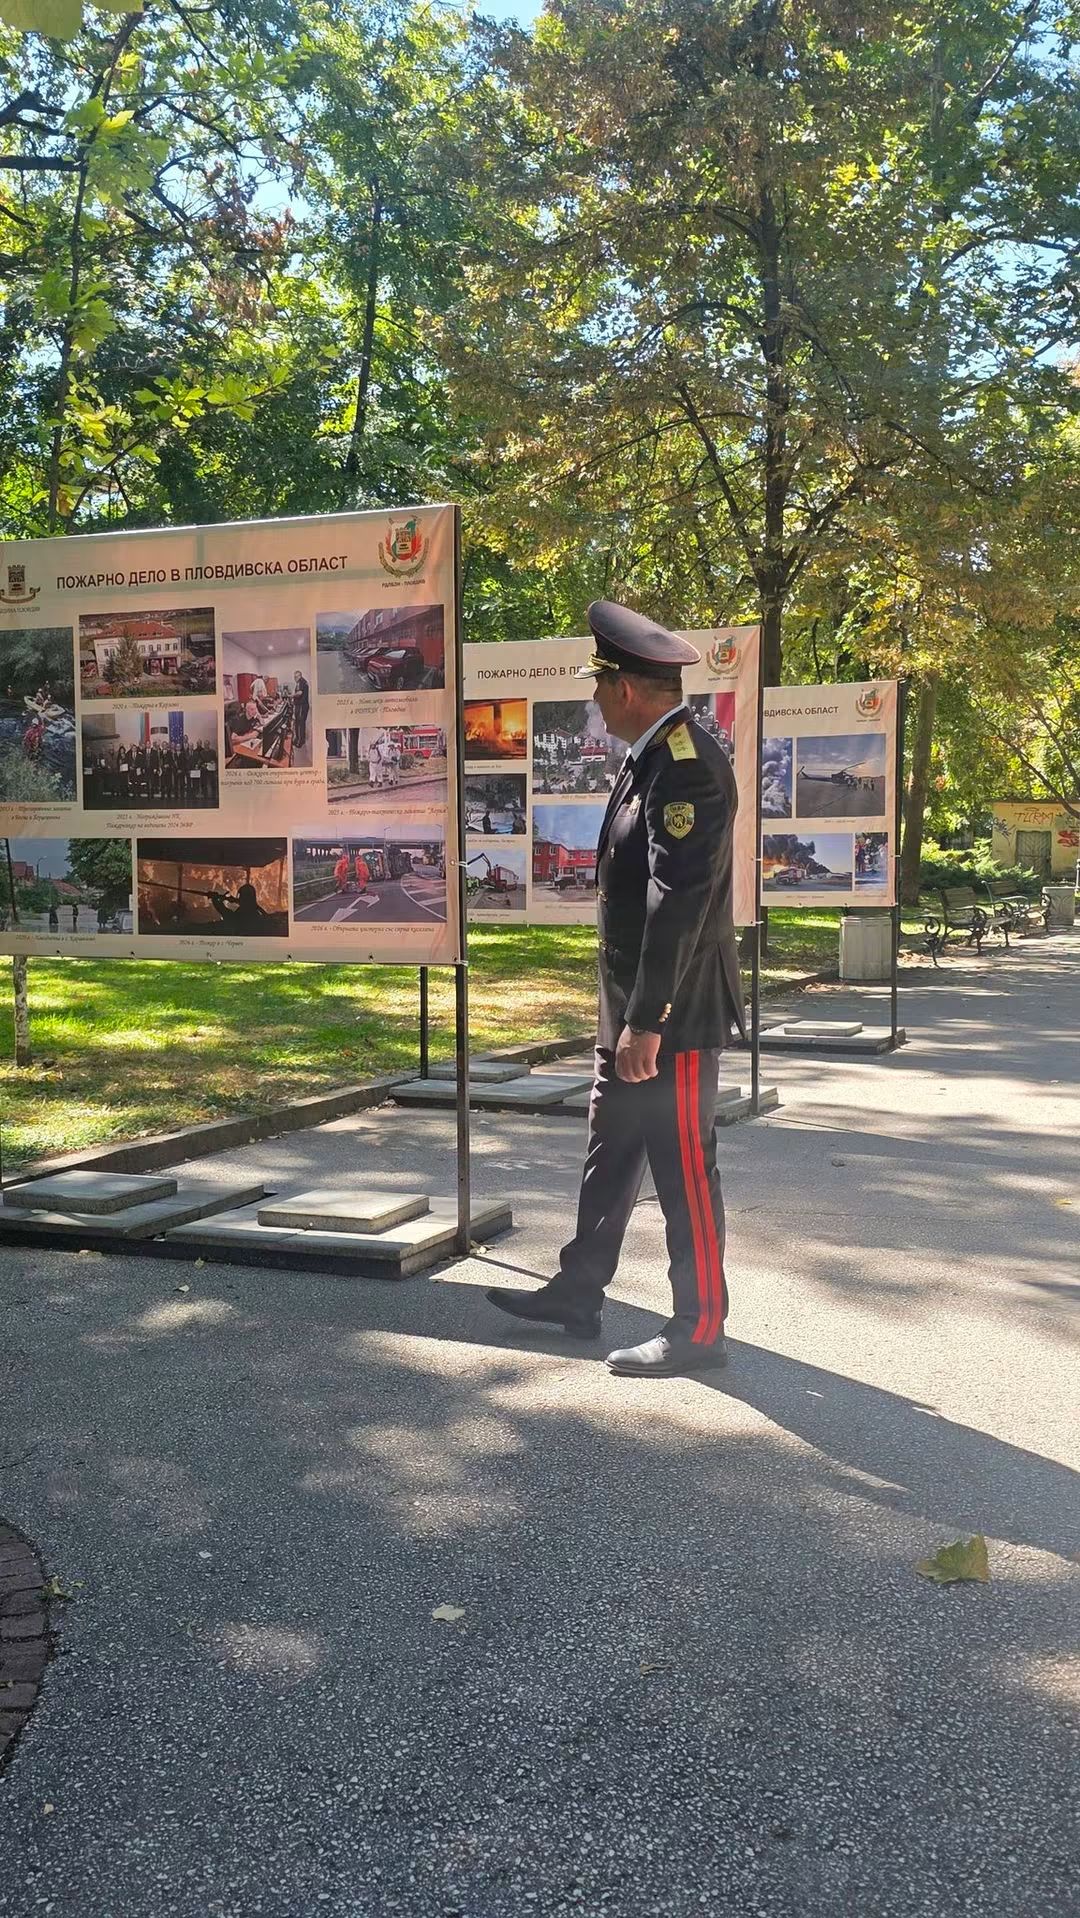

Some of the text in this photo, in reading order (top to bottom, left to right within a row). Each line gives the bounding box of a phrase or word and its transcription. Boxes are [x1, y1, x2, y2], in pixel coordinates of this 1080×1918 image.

[57, 555, 348, 589] ПОЖАРНО ДЕЛО В ПЛОВДИВСКА ОБЛАСТ
[477, 668, 527, 679] ПОЖАРНО
[529, 667, 557, 678] ДЕЛО
[559, 666, 566, 675] В
[764, 706, 839, 717] ВДИВСКА ОБЛАСТ
